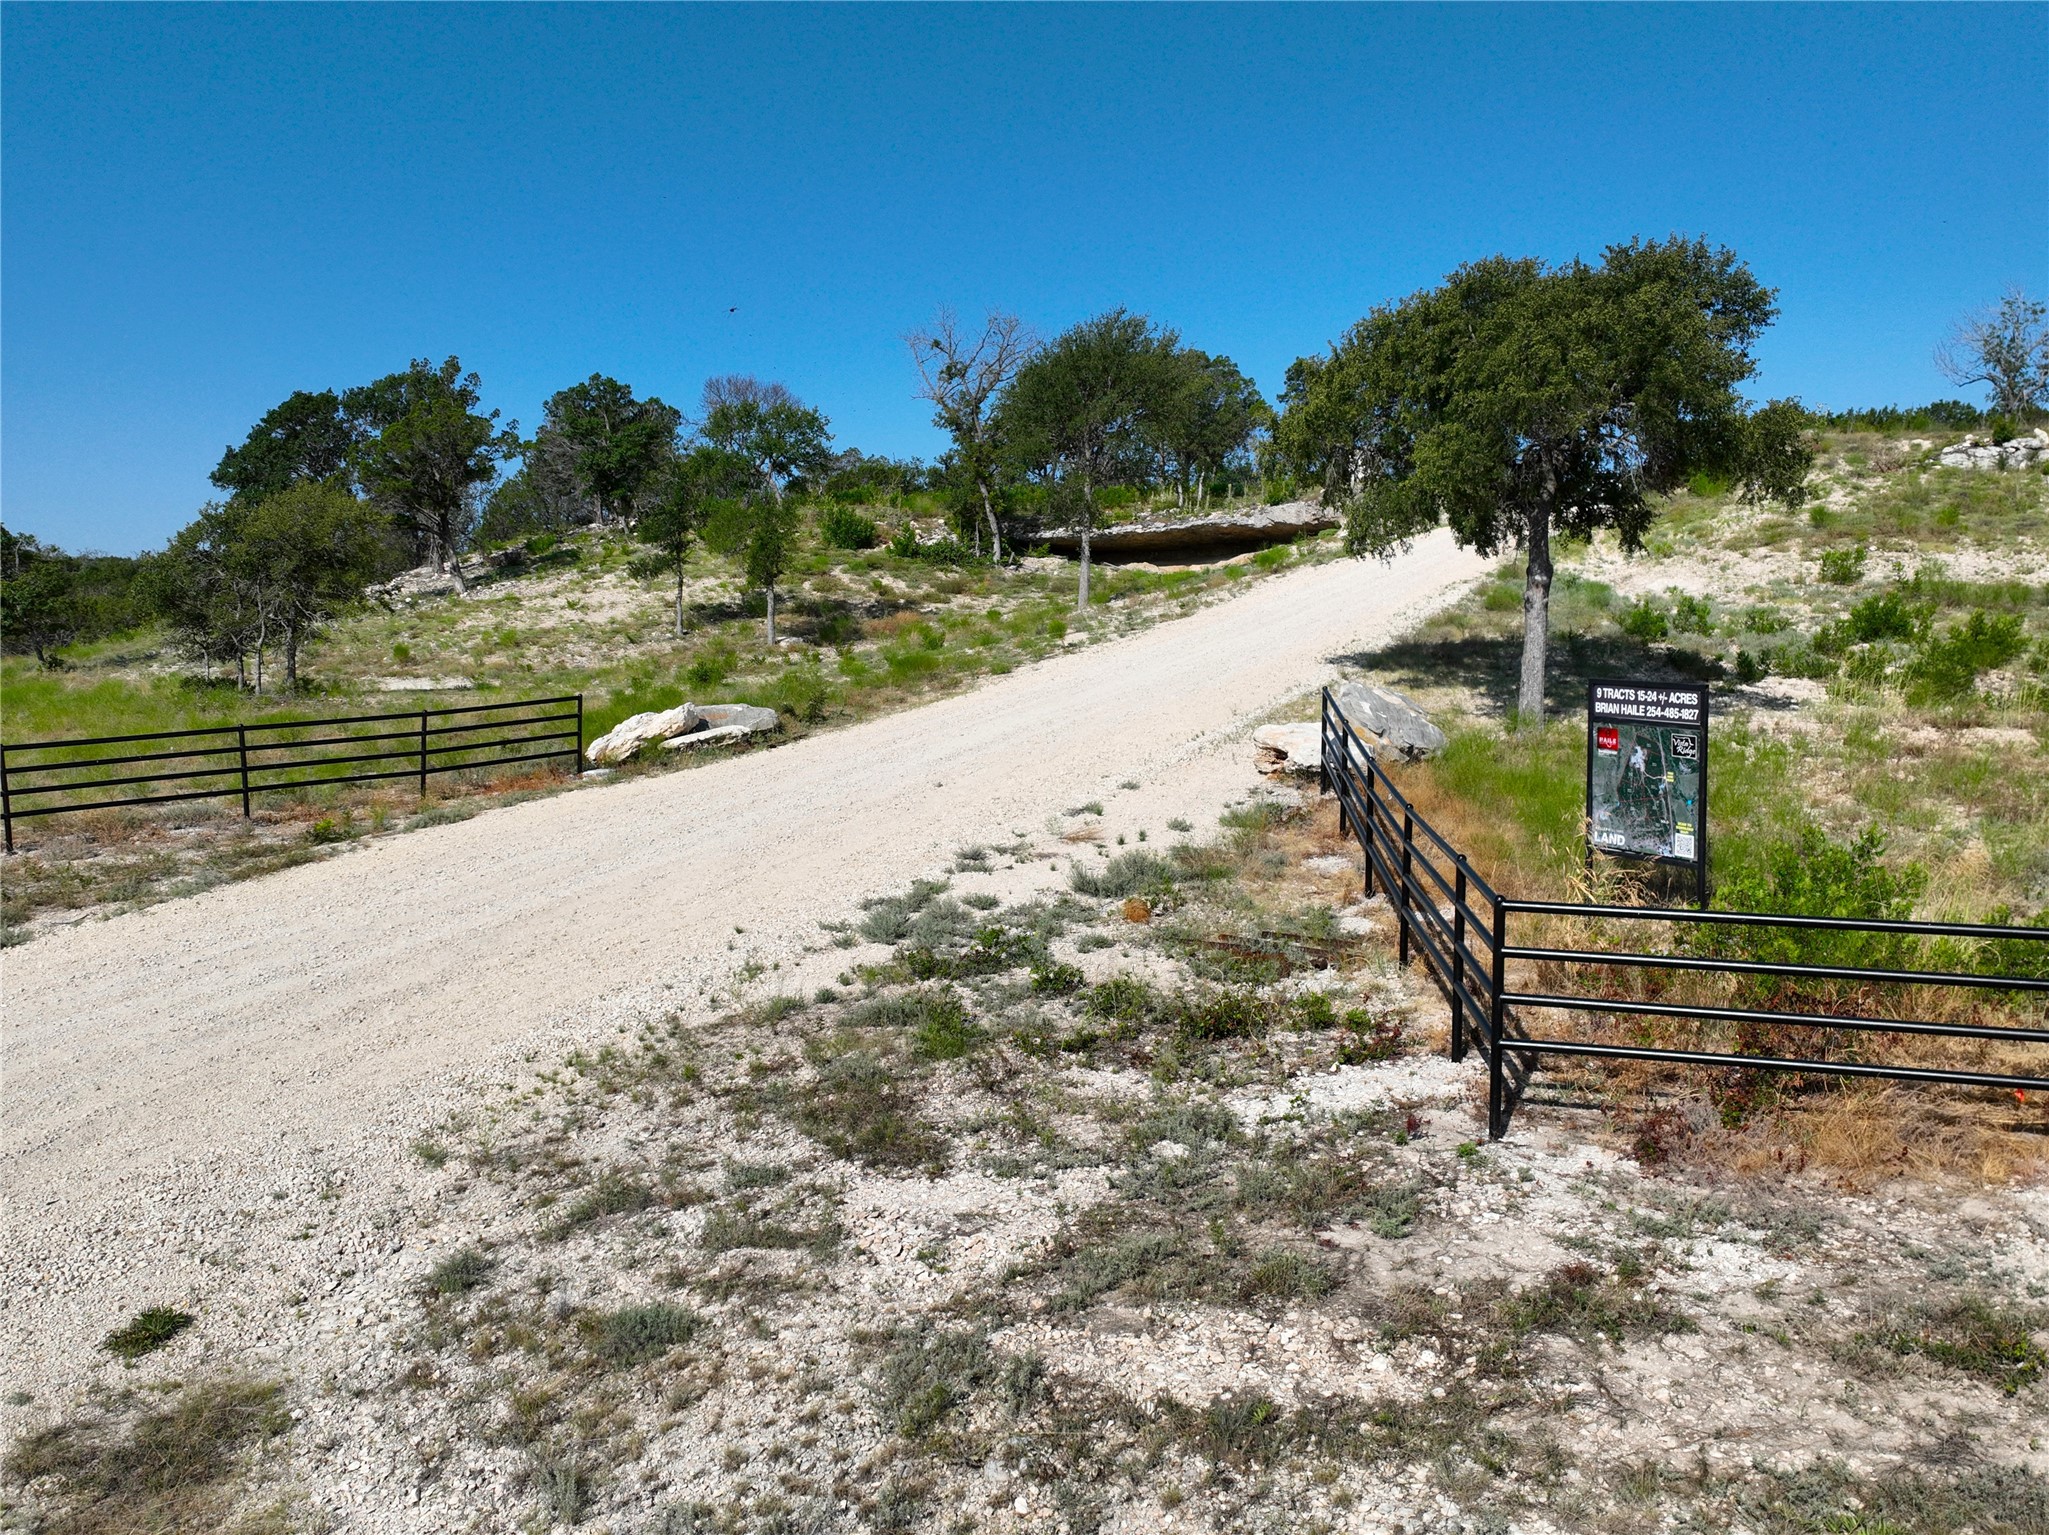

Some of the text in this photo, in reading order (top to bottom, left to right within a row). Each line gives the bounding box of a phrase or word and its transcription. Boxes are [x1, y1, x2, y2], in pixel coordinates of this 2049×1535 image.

[1596, 687, 1602, 699] 9
[1602, 687, 1636, 701] TRACTS
[1636, 690, 1657, 703] 15-24
[1668, 691, 1699, 706] ACRES
[1595, 701, 1700, 721] BRIAN HAILE 254-485-1827
[1594, 831, 1626, 846] LAND
